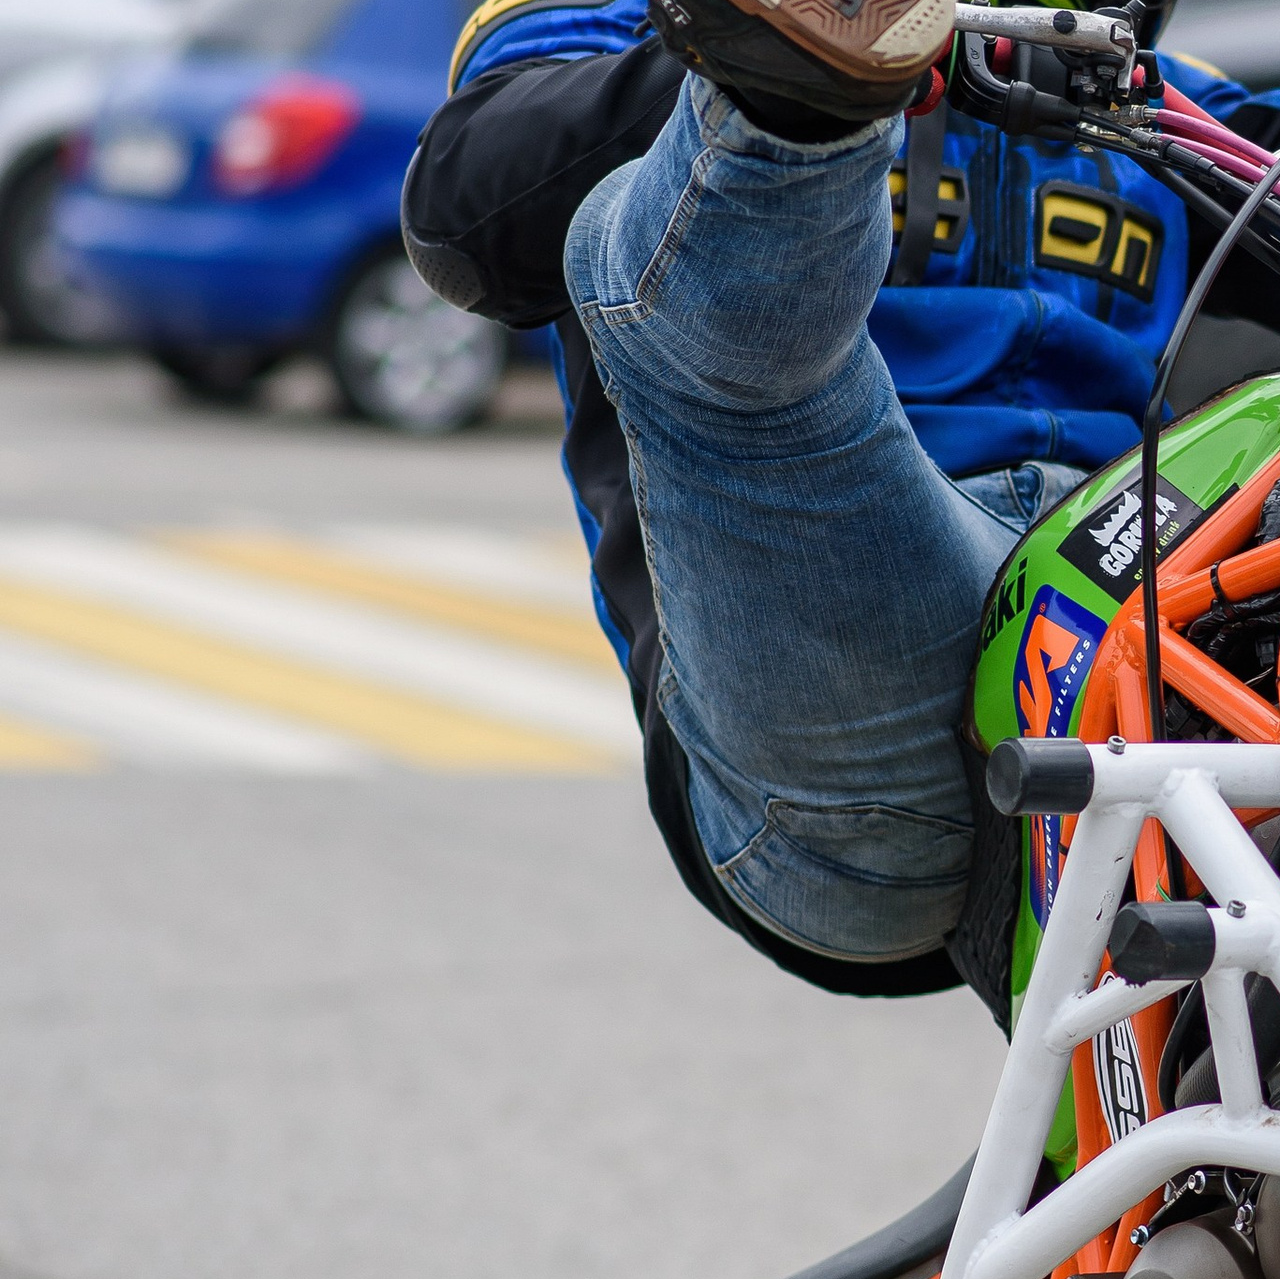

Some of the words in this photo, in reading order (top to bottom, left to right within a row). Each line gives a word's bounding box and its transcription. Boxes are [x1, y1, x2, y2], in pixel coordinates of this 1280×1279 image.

[1099, 494, 1178, 577] GORIA
[1158, 520, 1180, 547] drink
[1054, 639, 1091, 716] FILTERS
